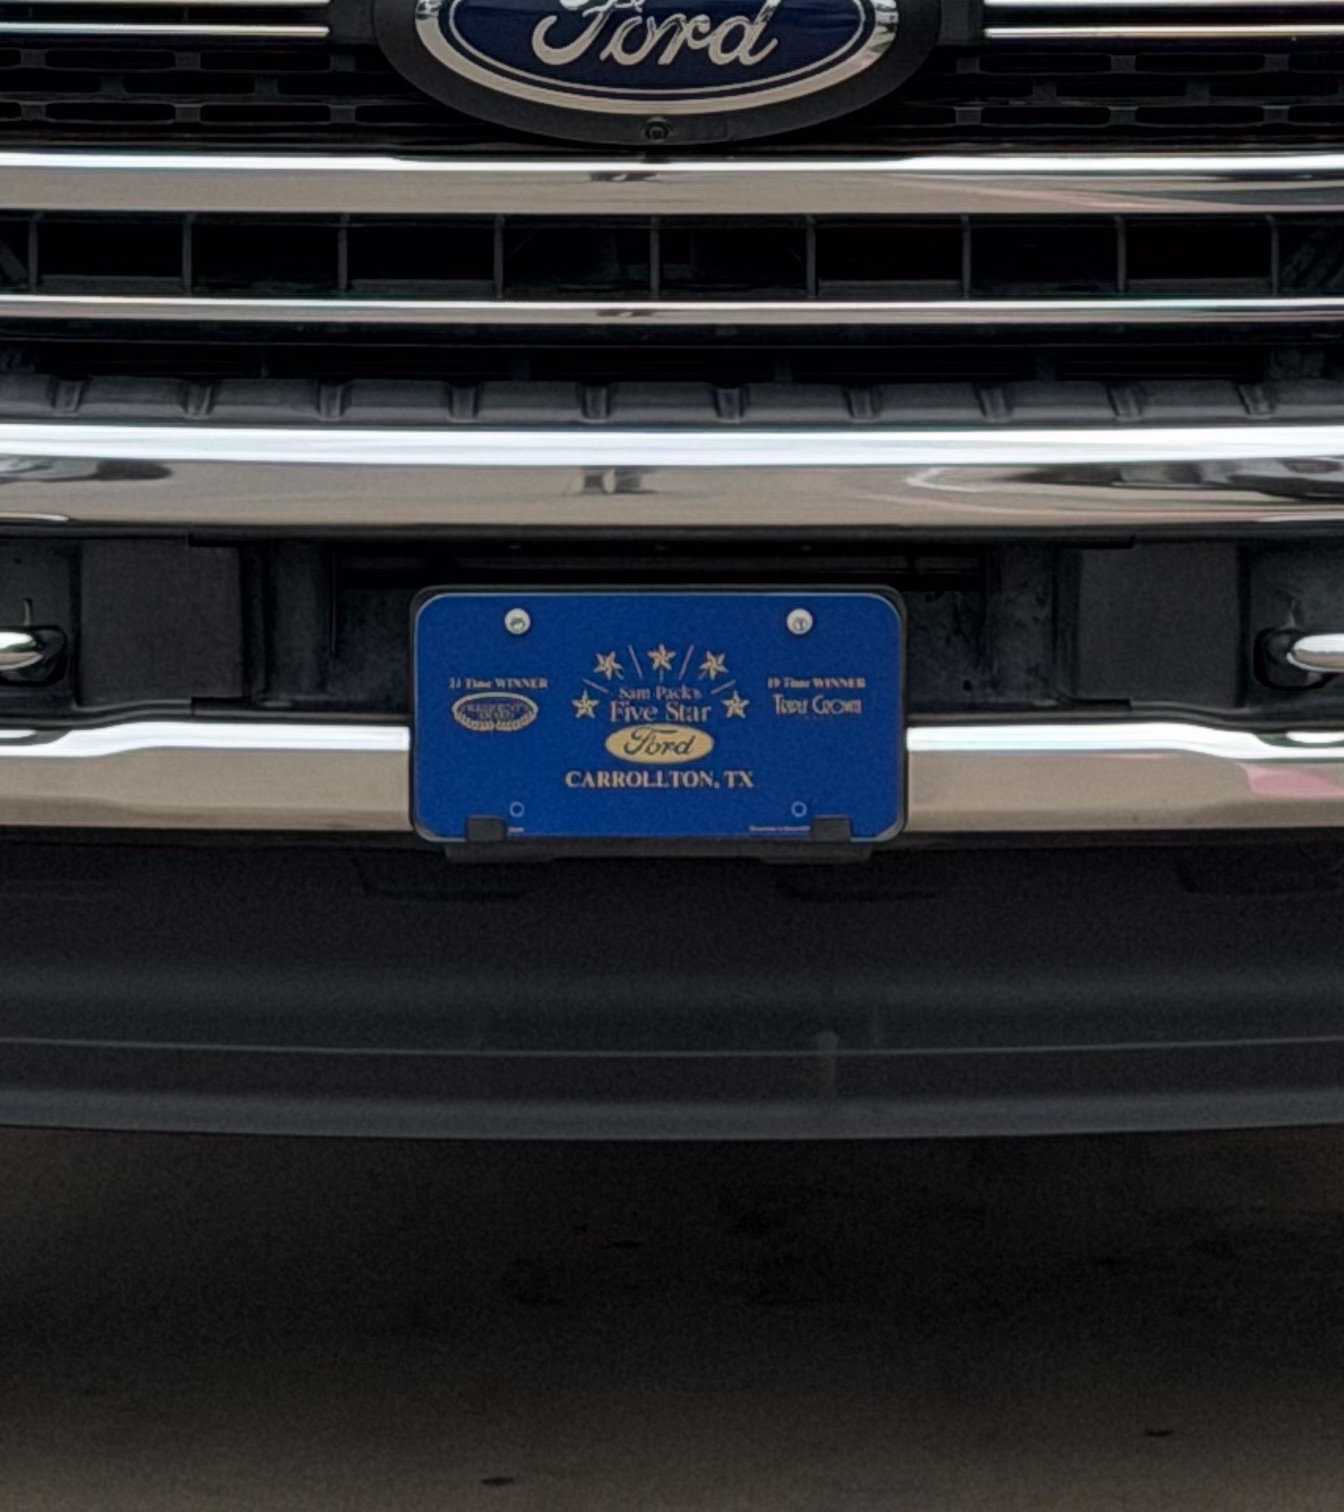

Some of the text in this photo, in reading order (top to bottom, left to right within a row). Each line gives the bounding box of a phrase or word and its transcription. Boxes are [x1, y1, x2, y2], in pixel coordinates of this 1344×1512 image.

[494, 677, 549, 690] WINNER
[812, 677, 867, 690] WINNER
[609, 700, 713, 723] Five Star
[622, 726, 697, 756] Ford
[564, 770, 754, 789] CARROLLTON, TX
